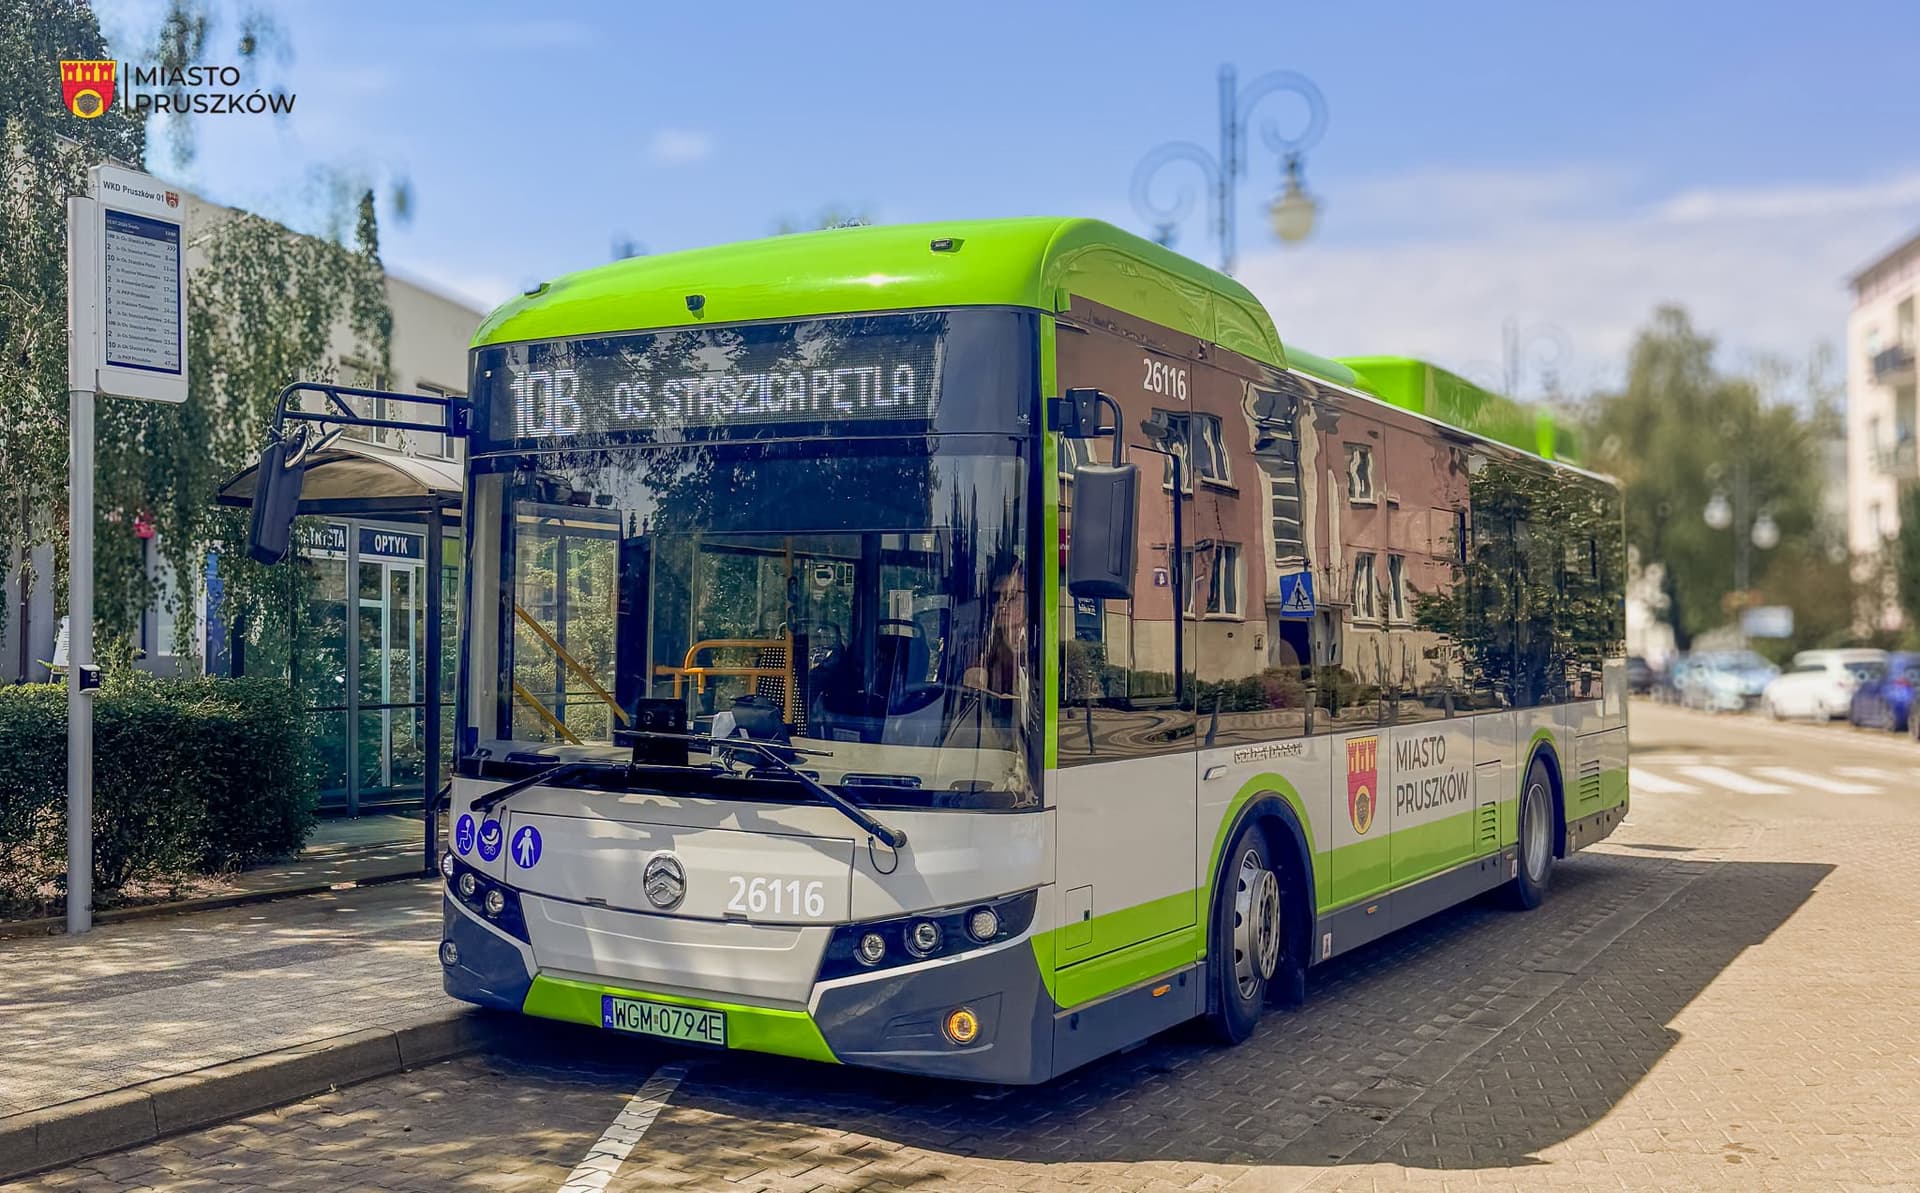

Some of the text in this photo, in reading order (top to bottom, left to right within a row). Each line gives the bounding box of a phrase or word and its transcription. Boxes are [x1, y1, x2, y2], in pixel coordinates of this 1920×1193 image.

[103, 180, 121, 192] WKD
[1143, 358, 1187, 400] 26116
[510, 369, 581, 438] 10B
[660, 373, 807, 417] STASZICA
[374, 534, 408, 554] OPTYK
[1396, 735, 1446, 773] MIASTO
[1396, 766, 1469, 817] PRUSZKÓW
[727, 876, 825, 917] 26116
[614, 1001, 722, 1042] WGM 0794E
